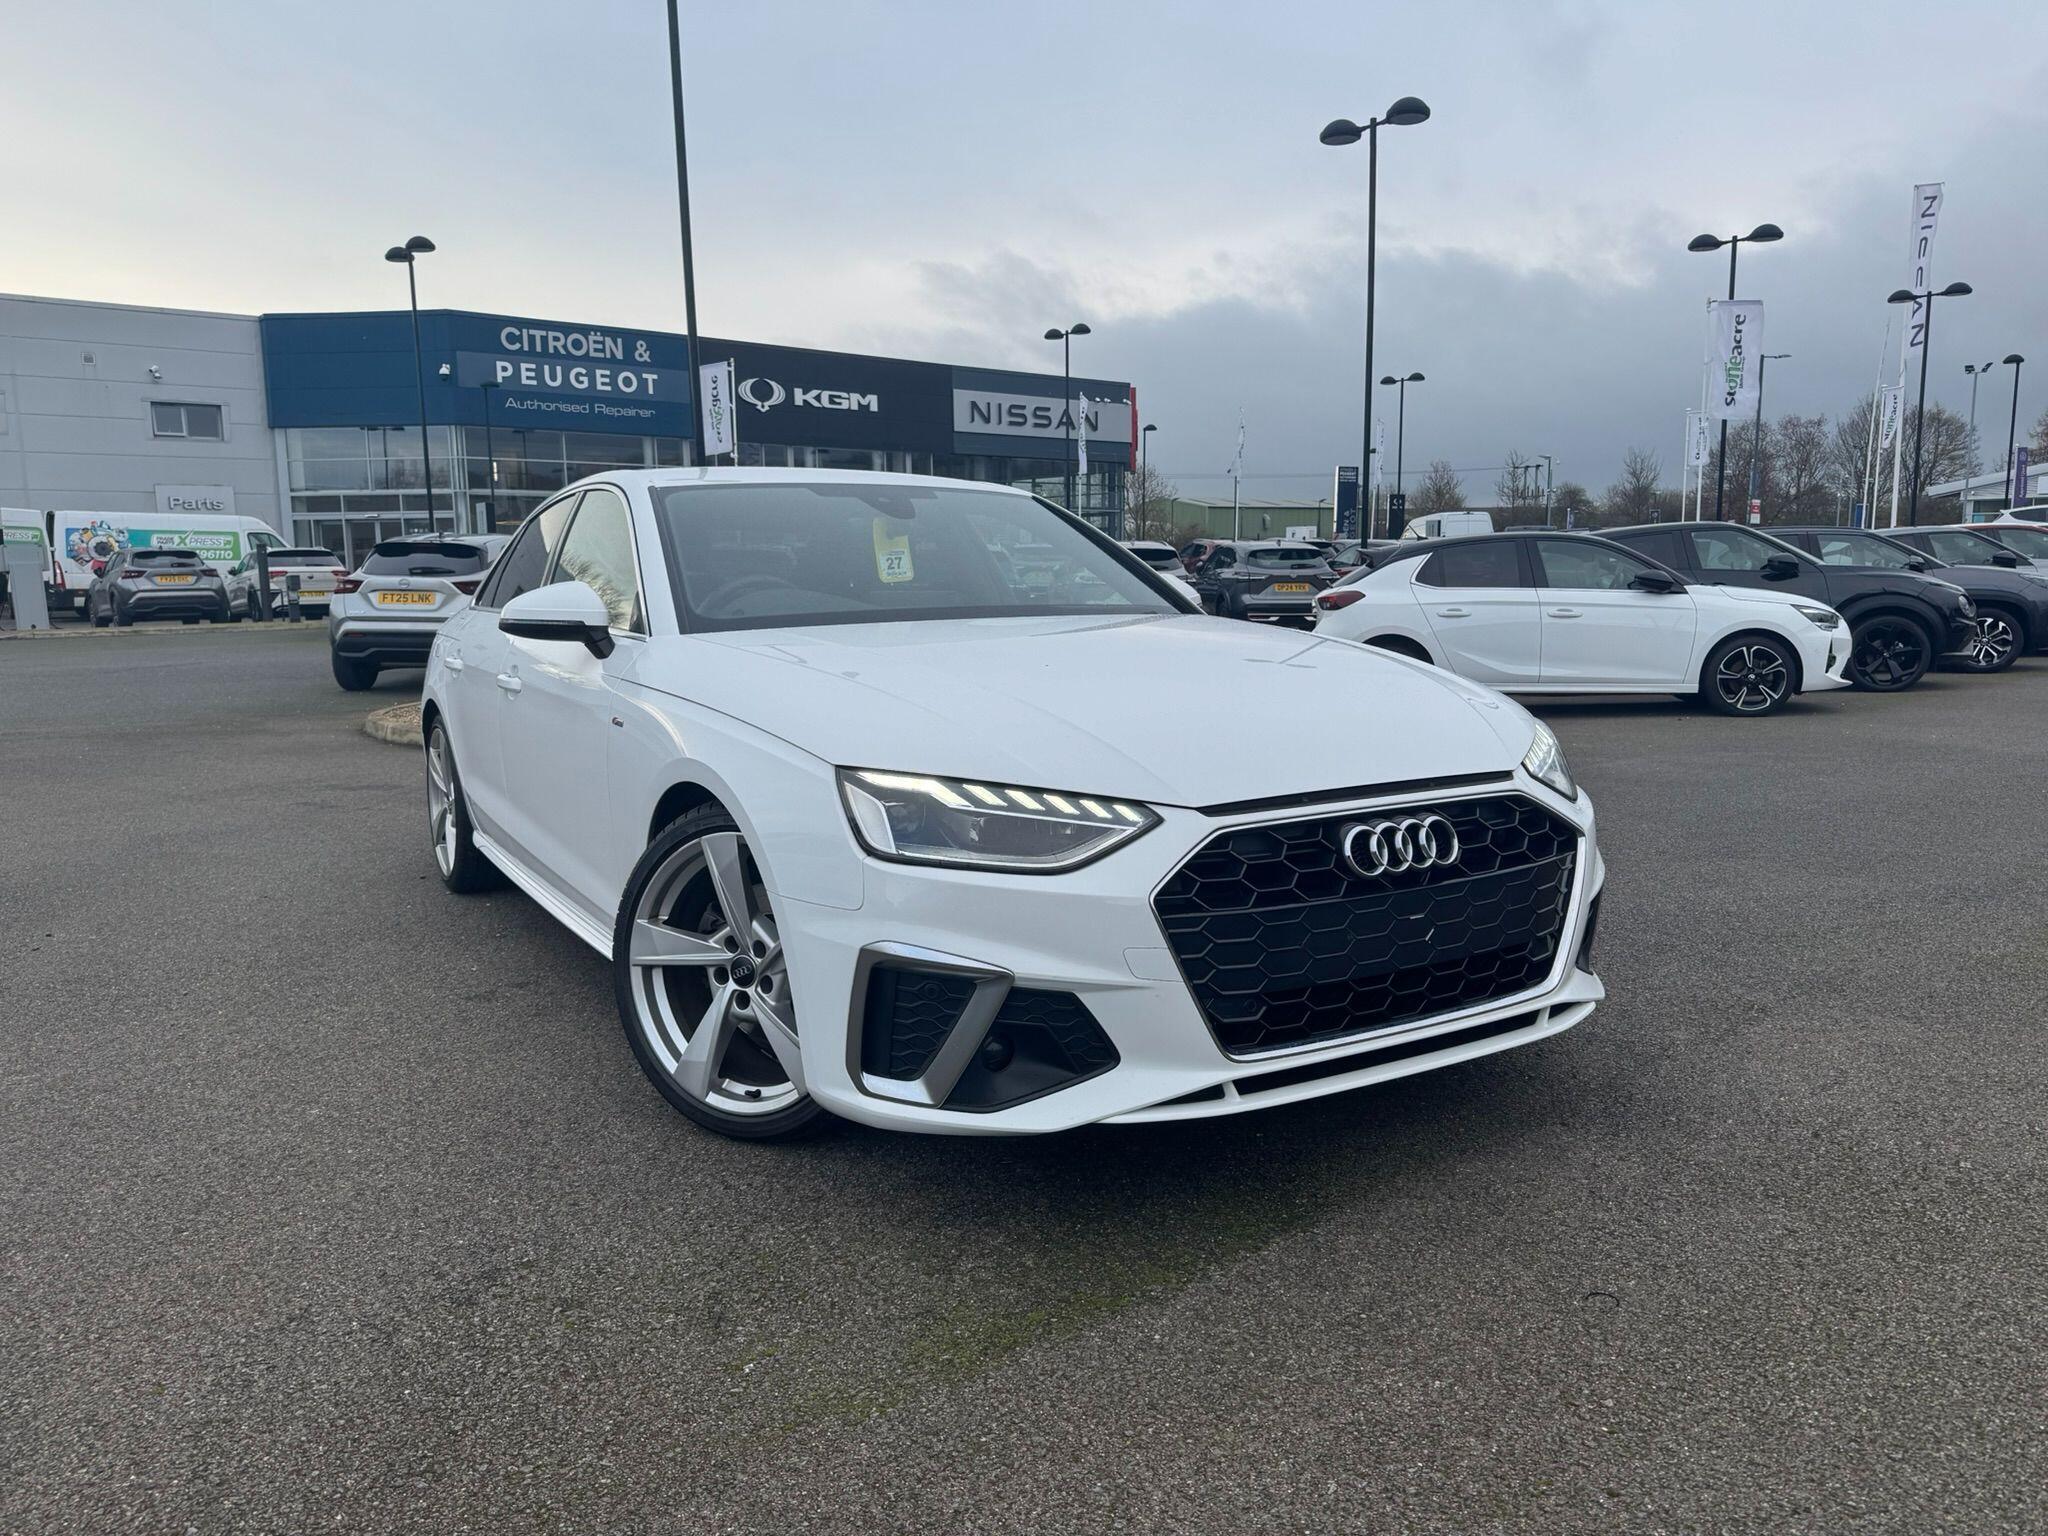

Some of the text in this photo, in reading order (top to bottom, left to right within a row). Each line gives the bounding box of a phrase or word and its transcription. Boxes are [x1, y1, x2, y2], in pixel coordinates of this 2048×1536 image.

[500, 326, 652, 362] CITROËN &
[1724, 313, 1747, 407] Stoneacre
[495, 360, 659, 395] PEUGEOT
[505, 397, 656, 418] Authorised Repairer
[793, 387, 879, 412] KGM
[969, 400, 1099, 432] NISSAN
[168, 495, 224, 511] Parts
[886, 556, 903, 570] 27
[381, 593, 432, 604] FT25 LNK
